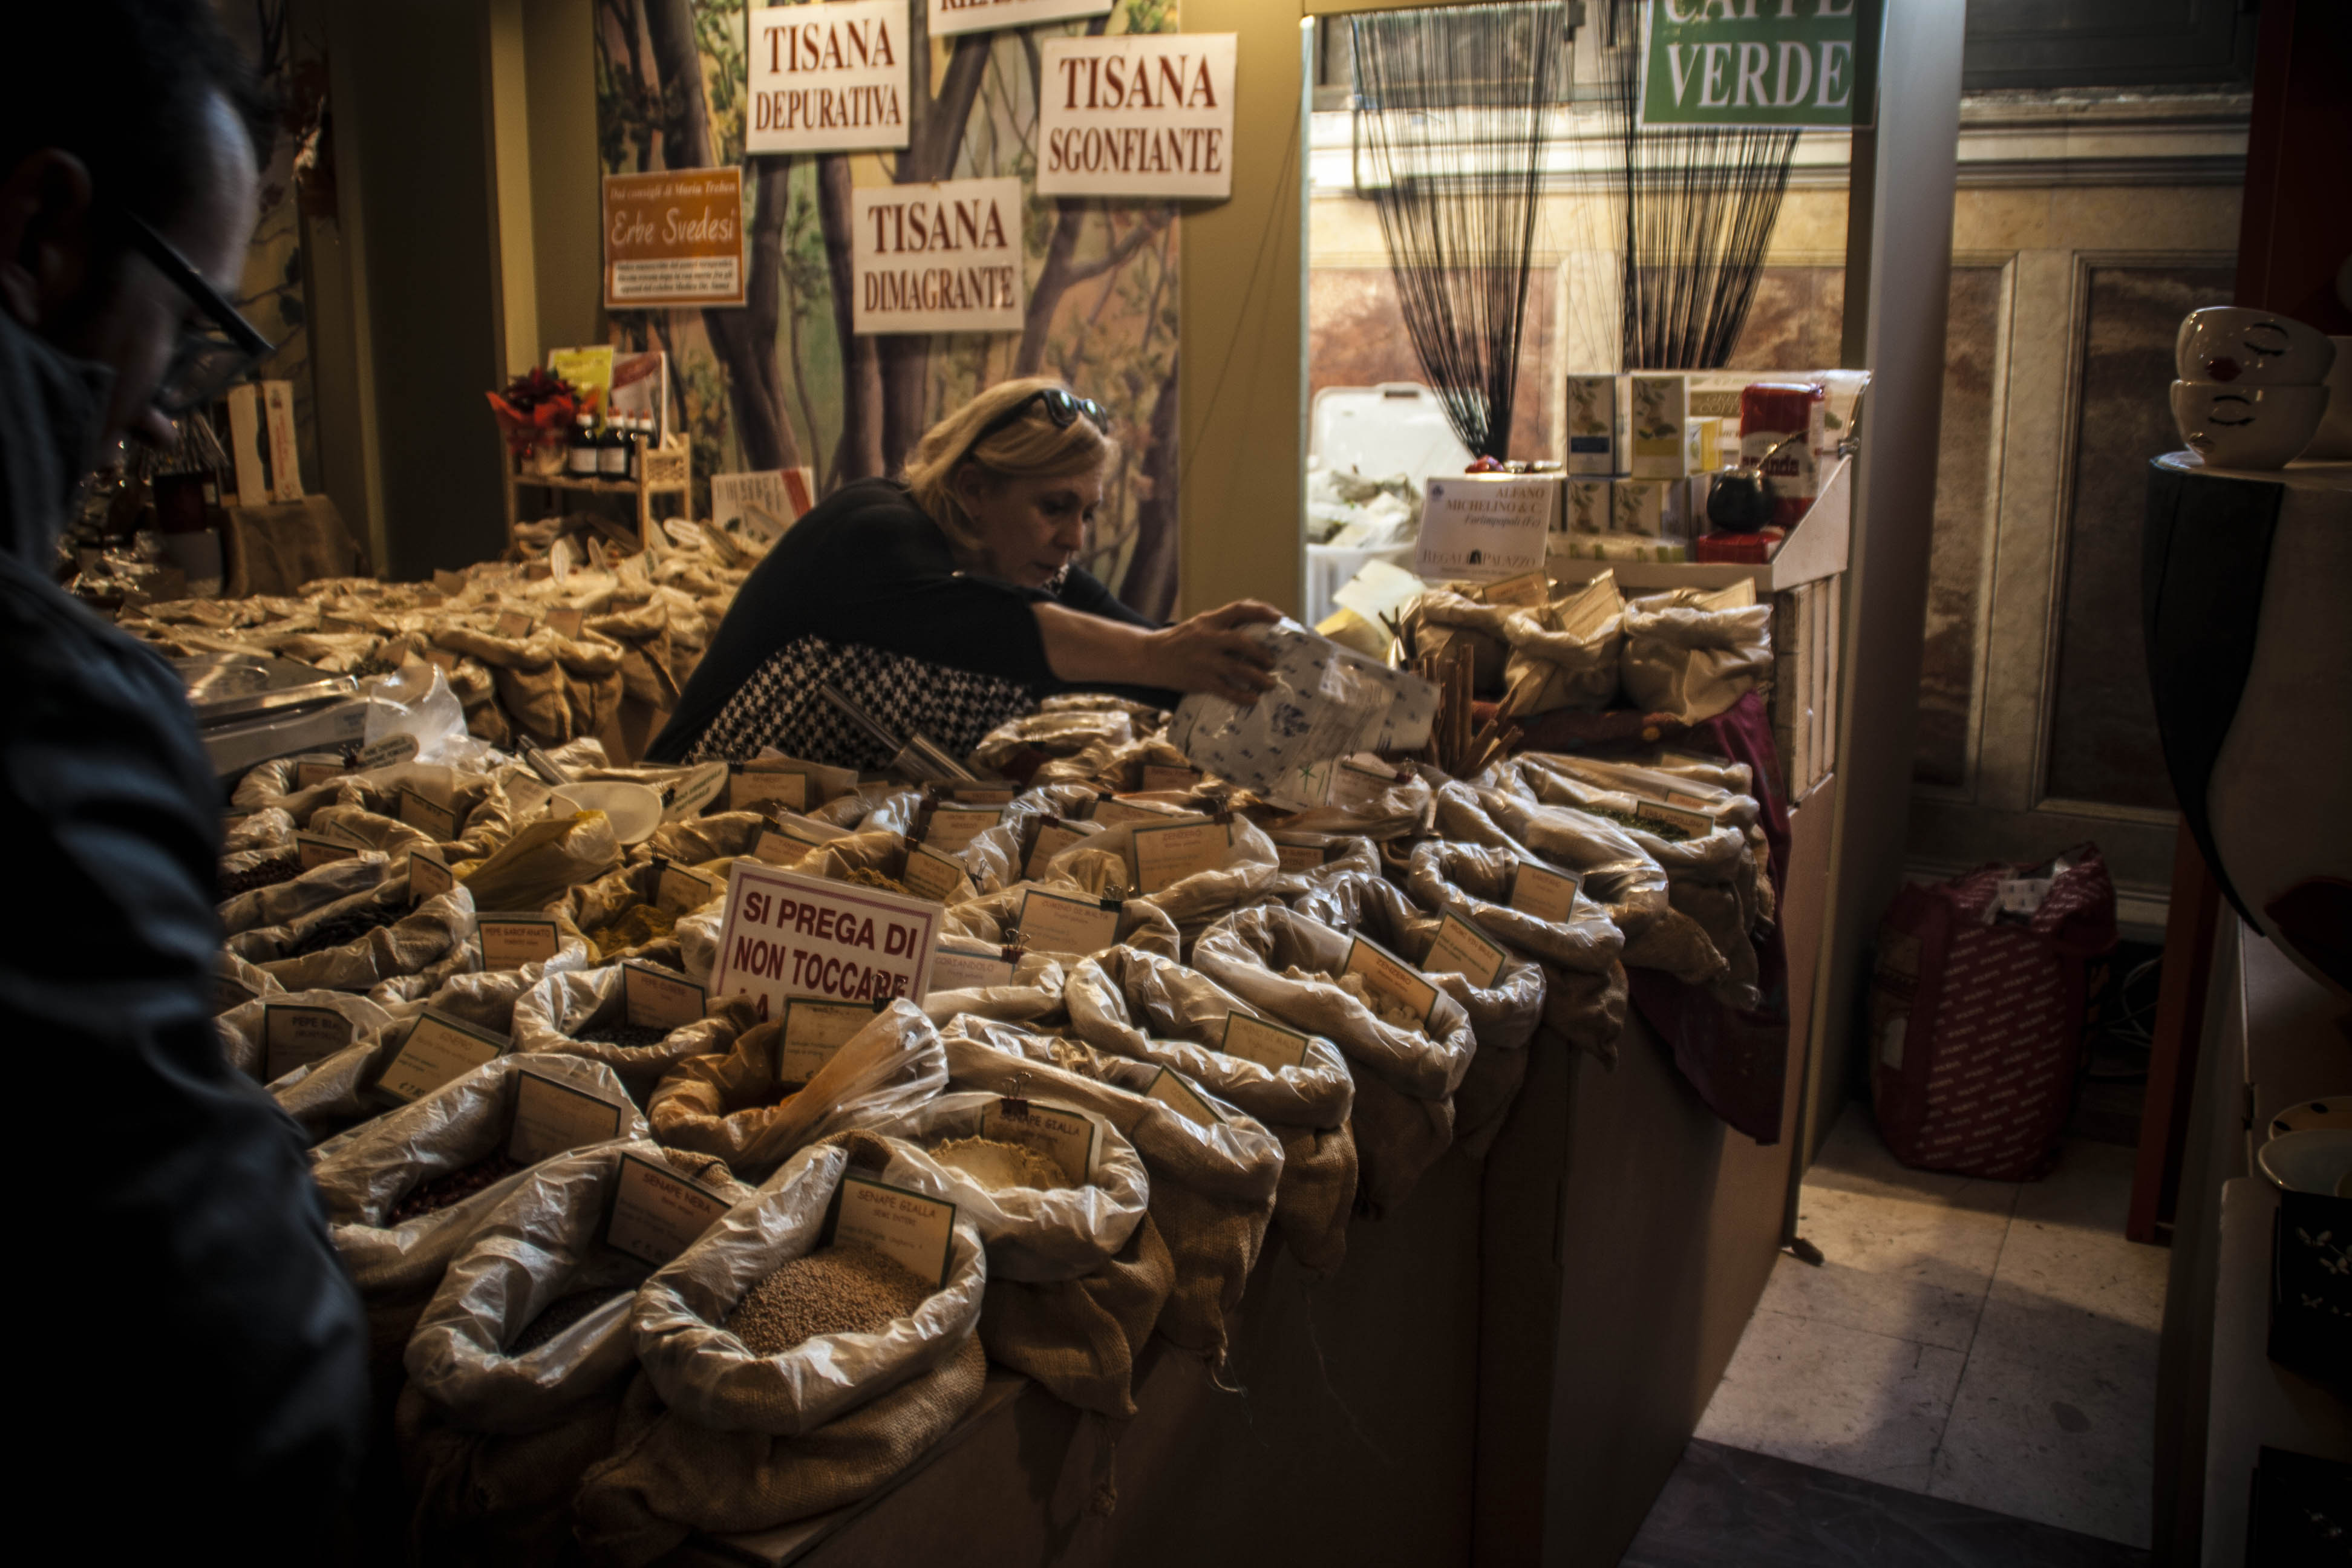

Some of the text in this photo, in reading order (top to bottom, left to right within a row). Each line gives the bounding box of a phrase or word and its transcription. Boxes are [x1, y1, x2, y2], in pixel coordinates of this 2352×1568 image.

[763, 18, 895, 73] TISANA
[1059, 53, 1217, 109] TISANA
[1666, 40, 1853, 109] VERDE
[756, 84, 901, 131] DEPURATIVA
[1048, 126, 1223, 174] SGONFIANTE
[611, 205, 737, 246] Erbe Svedesi
[867, 197, 1007, 253] TISANA
[864, 266, 1015, 312] DIMAGRANTE
[743, 892, 918, 959] SI PREGA DI
[733, 936, 909, 1001] NON TOCCARE
[292, 1016, 319, 1027] PEPE
[1045, 1119, 1080, 1136] GIALLA
[642, 1172, 683, 1199] SENAPE
[685, 1192, 712, 1215] NERA
[857, 1189, 936, 1219] SENAPE GIALLA
